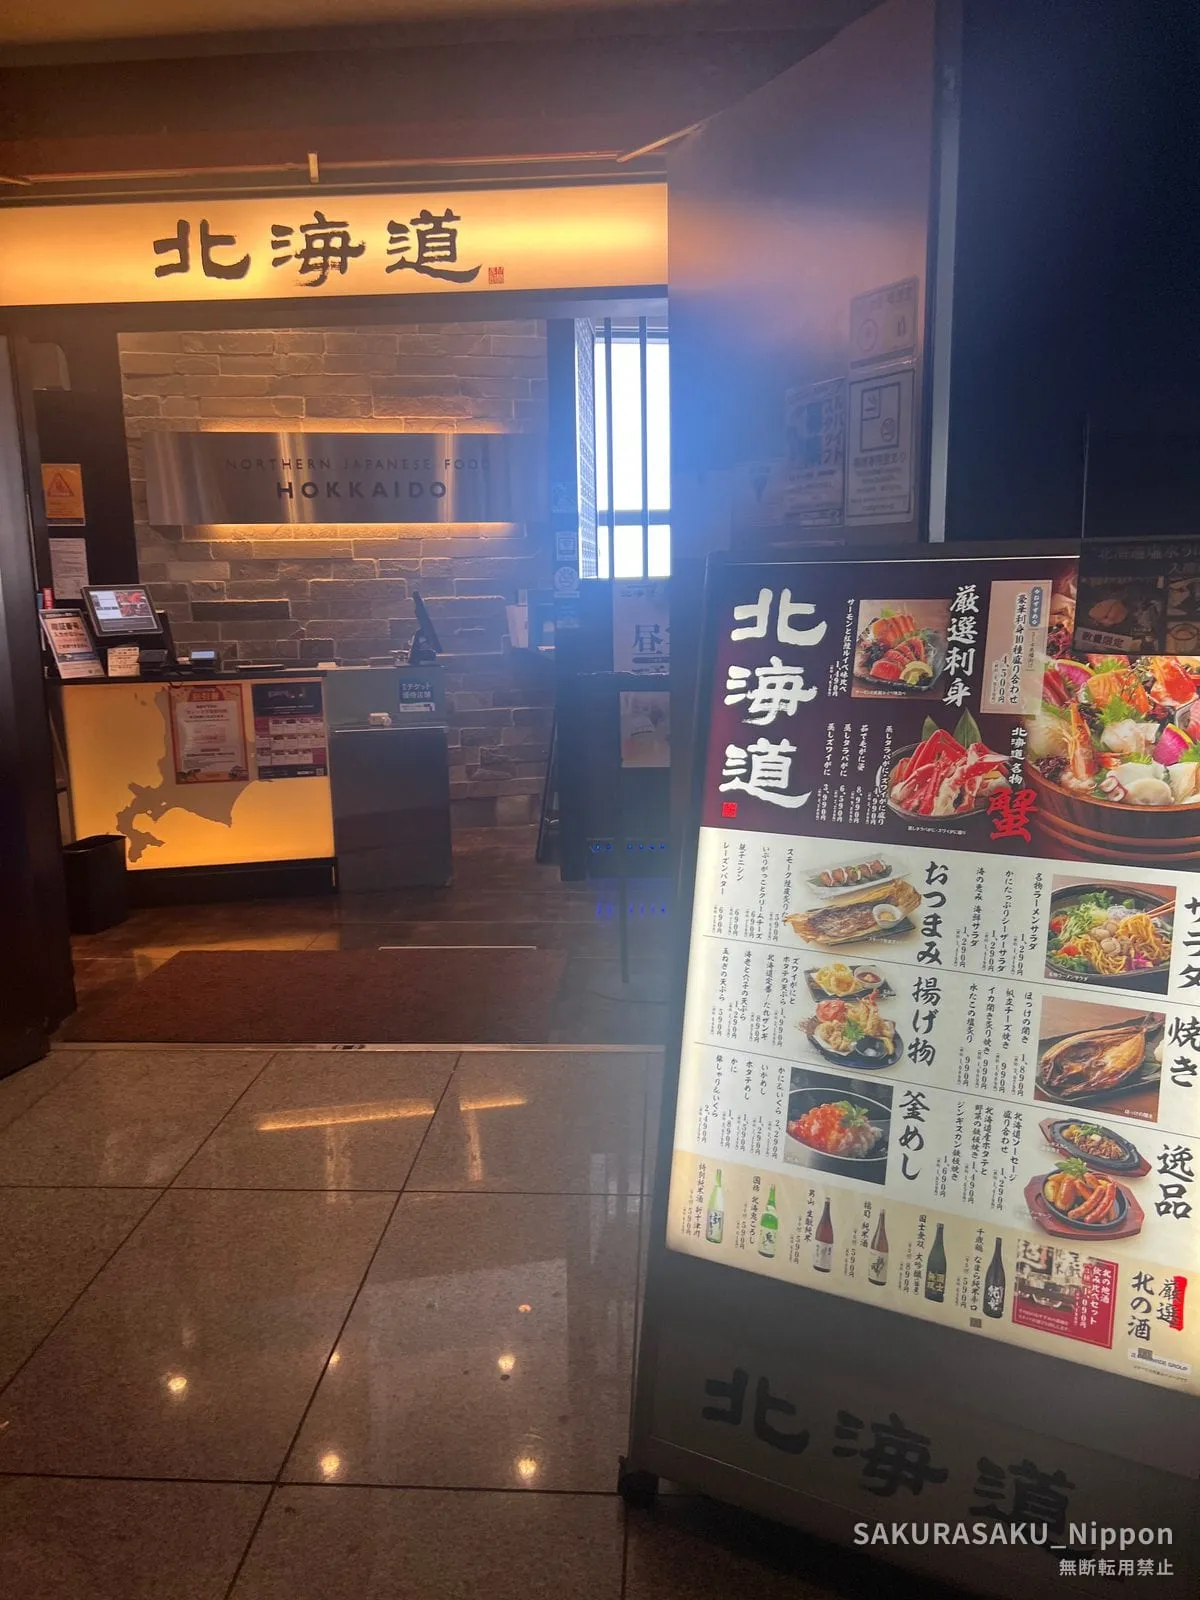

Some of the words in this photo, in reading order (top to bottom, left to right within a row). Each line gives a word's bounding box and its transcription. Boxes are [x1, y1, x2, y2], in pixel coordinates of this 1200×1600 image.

[153, 207, 482, 288] 北海道
[226, 458, 331, 472] NORTHERN
[344, 458, 431, 472] JAPANESE
[277, 481, 447, 499] HOKKAIDO
[942, 584, 979, 708] 厳選刺身
[719, 588, 827, 808] 北海道
[986, 787, 1039, 843] 蟹
[720, 842, 729, 896] レーズンバター
[916, 860, 949, 966] おつまみ
[997, 870, 1015, 972] かにたっぷりシーザーサラダ
[1028, 872, 1043, 951] 名物ラーメンサラダ
[719, 948, 729, 1002] 玉ねぎの天ぷら
[780, 956, 789, 1005] ホタテの天ぷら
[908, 977, 941, 1067] 揚げ物
[1002, 988, 1015, 1049] 帆立チーズ焼き
[1021, 992, 1033, 1044] ほっけの開き
[1168, 1015, 1200, 1088] 焼き
[730, 1058, 738, 1073] かに
[744, 1061, 753, 1100] ホタテめし
[760, 1064, 768, 1095] いかめし
[775, 1067, 785, 1115] かにといくら
[898, 1090, 930, 1180] 釜めし
[951, 1101, 965, 1182] ジンギスカン鉄板焼き
[980, 1106, 994, 1176] 北海道産ホタテと
[1008, 1112, 1023, 1182] 北海道ソーセージ
[1154, 1143, 1195, 1219] 逸品
[1127, 1271, 1154, 1341] 北の酒
[1156, 1278, 1178, 1327] 厳選
[701, 1366, 1105, 1558] 北海道
